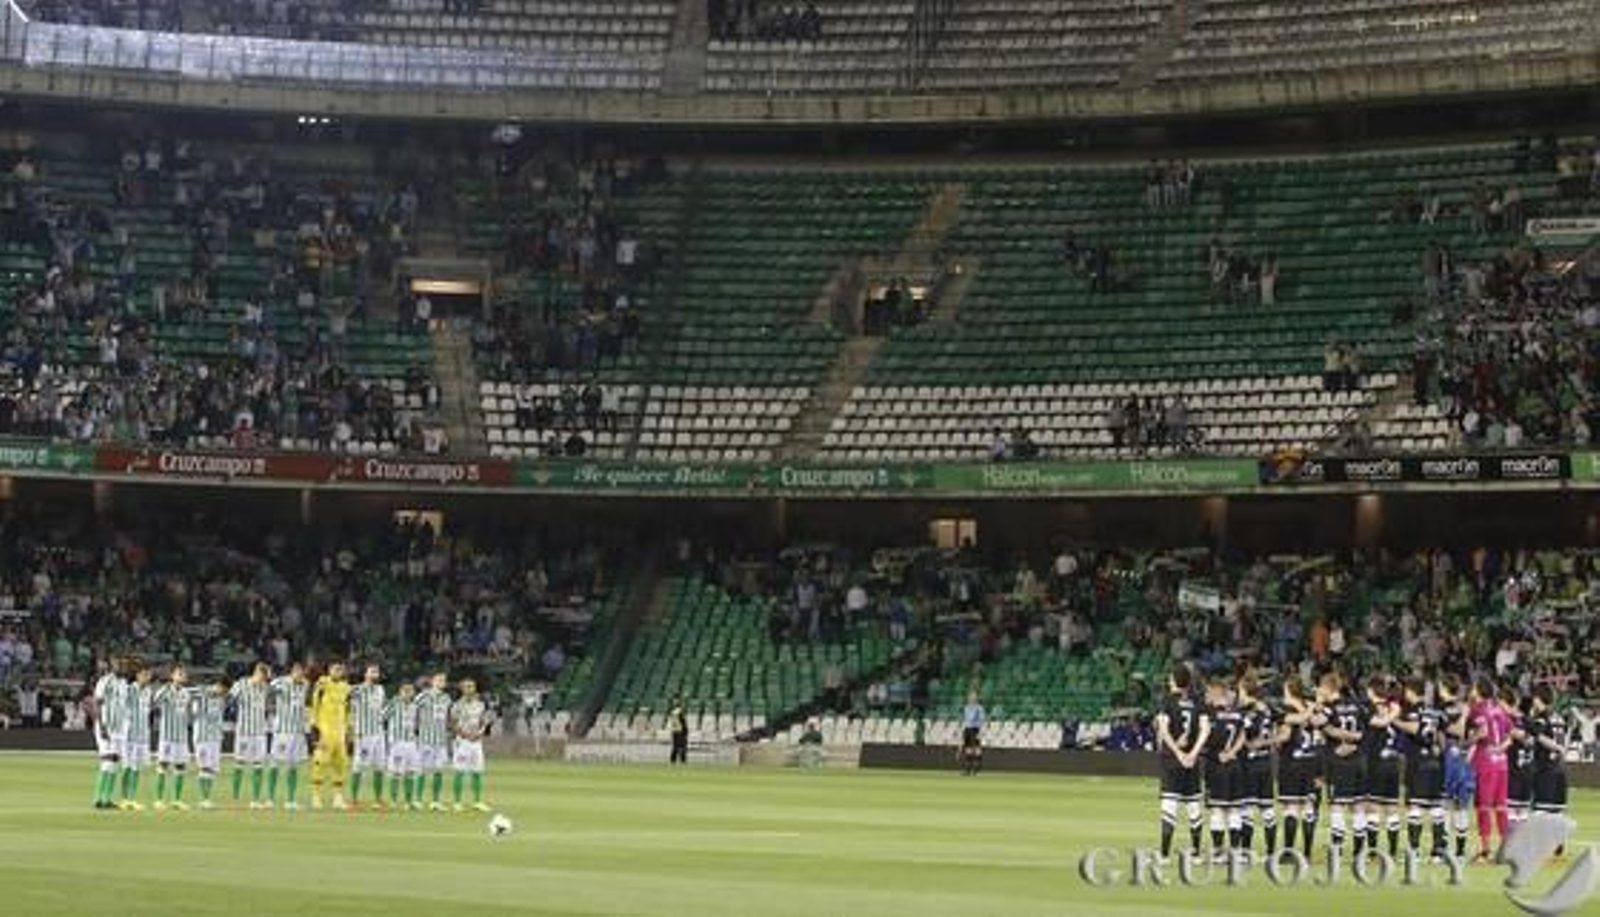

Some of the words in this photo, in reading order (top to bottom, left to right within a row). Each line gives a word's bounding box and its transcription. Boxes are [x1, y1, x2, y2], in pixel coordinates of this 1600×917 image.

[158, 452, 251, 477] Cruzcampo
[364, 458, 465, 485] Cruzcampo
[606, 465, 668, 487] quiere
[780, 466, 874, 490] Cruzcampo
